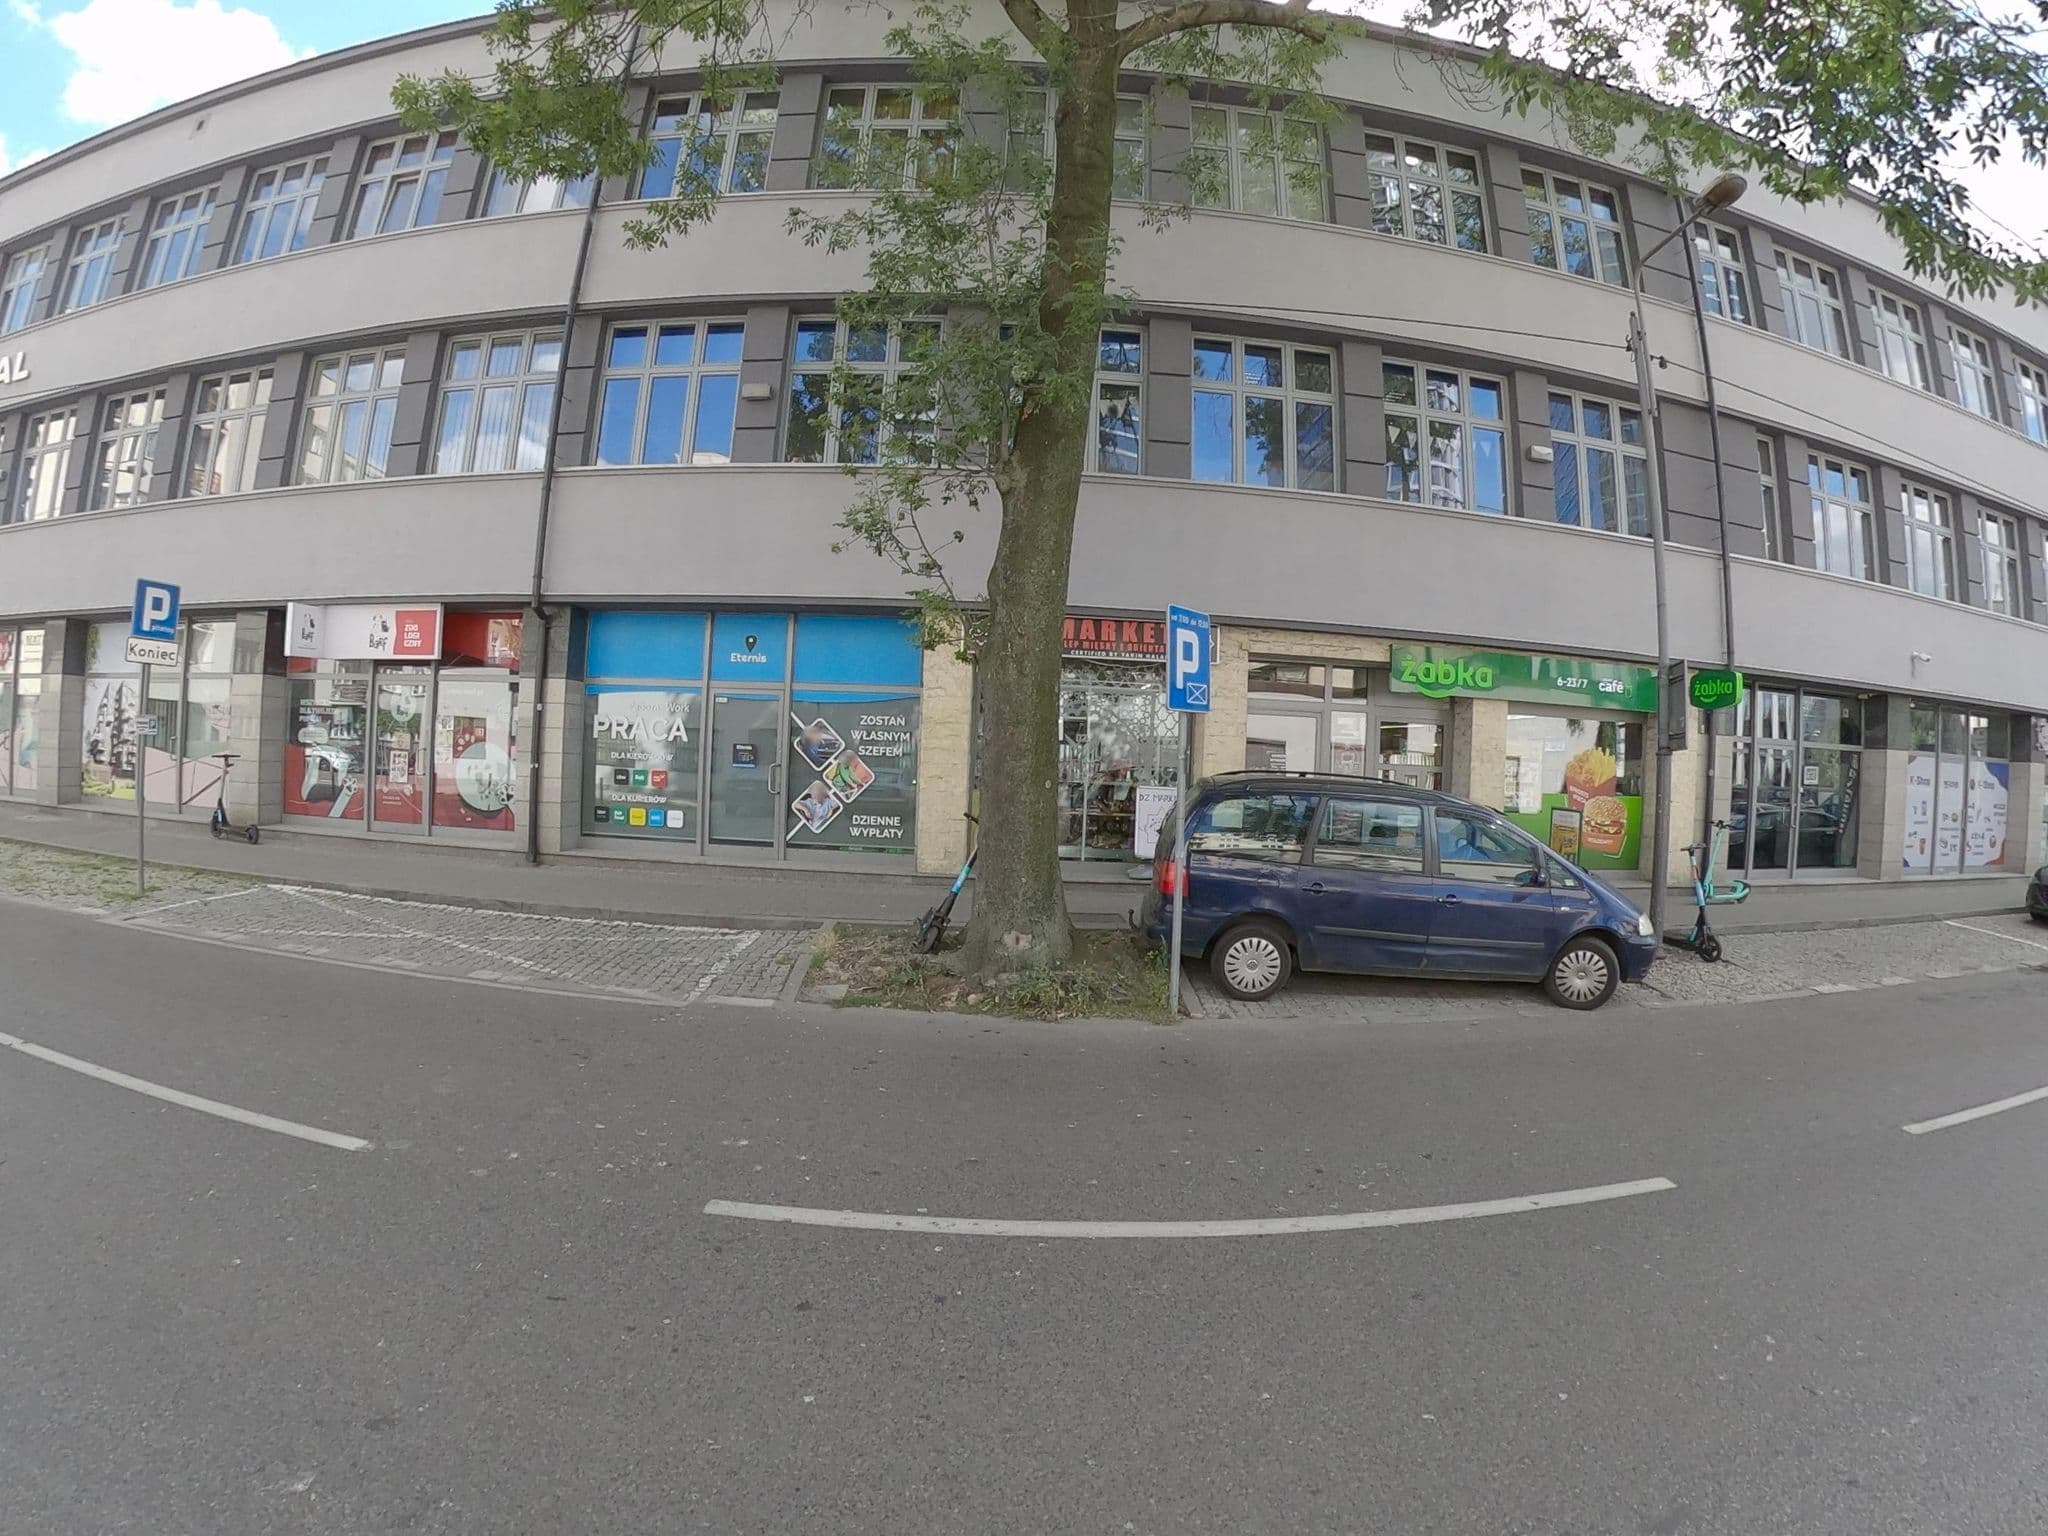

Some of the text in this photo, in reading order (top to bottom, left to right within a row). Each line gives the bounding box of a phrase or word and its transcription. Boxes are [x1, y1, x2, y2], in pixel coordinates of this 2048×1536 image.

[142, 587, 171, 631] P
[129, 643, 176, 661] Koniec
[731, 653, 767, 663] Eternis
[1176, 628, 1199, 689] P
[1400, 655, 1493, 688] żabka
[1694, 681, 1733, 696] żabka
[860, 714, 905, 726] ZOSTAŃ
[593, 714, 689, 742] PRACA
[850, 730, 910, 742] WŁASNYM
[611, 751, 625, 760] DLA
[858, 746, 903, 757] SZEFEM
[611, 793, 626, 801] DLA
[852, 815, 901, 826] DZIENNE
[849, 827, 903, 839] WYPŁATY
